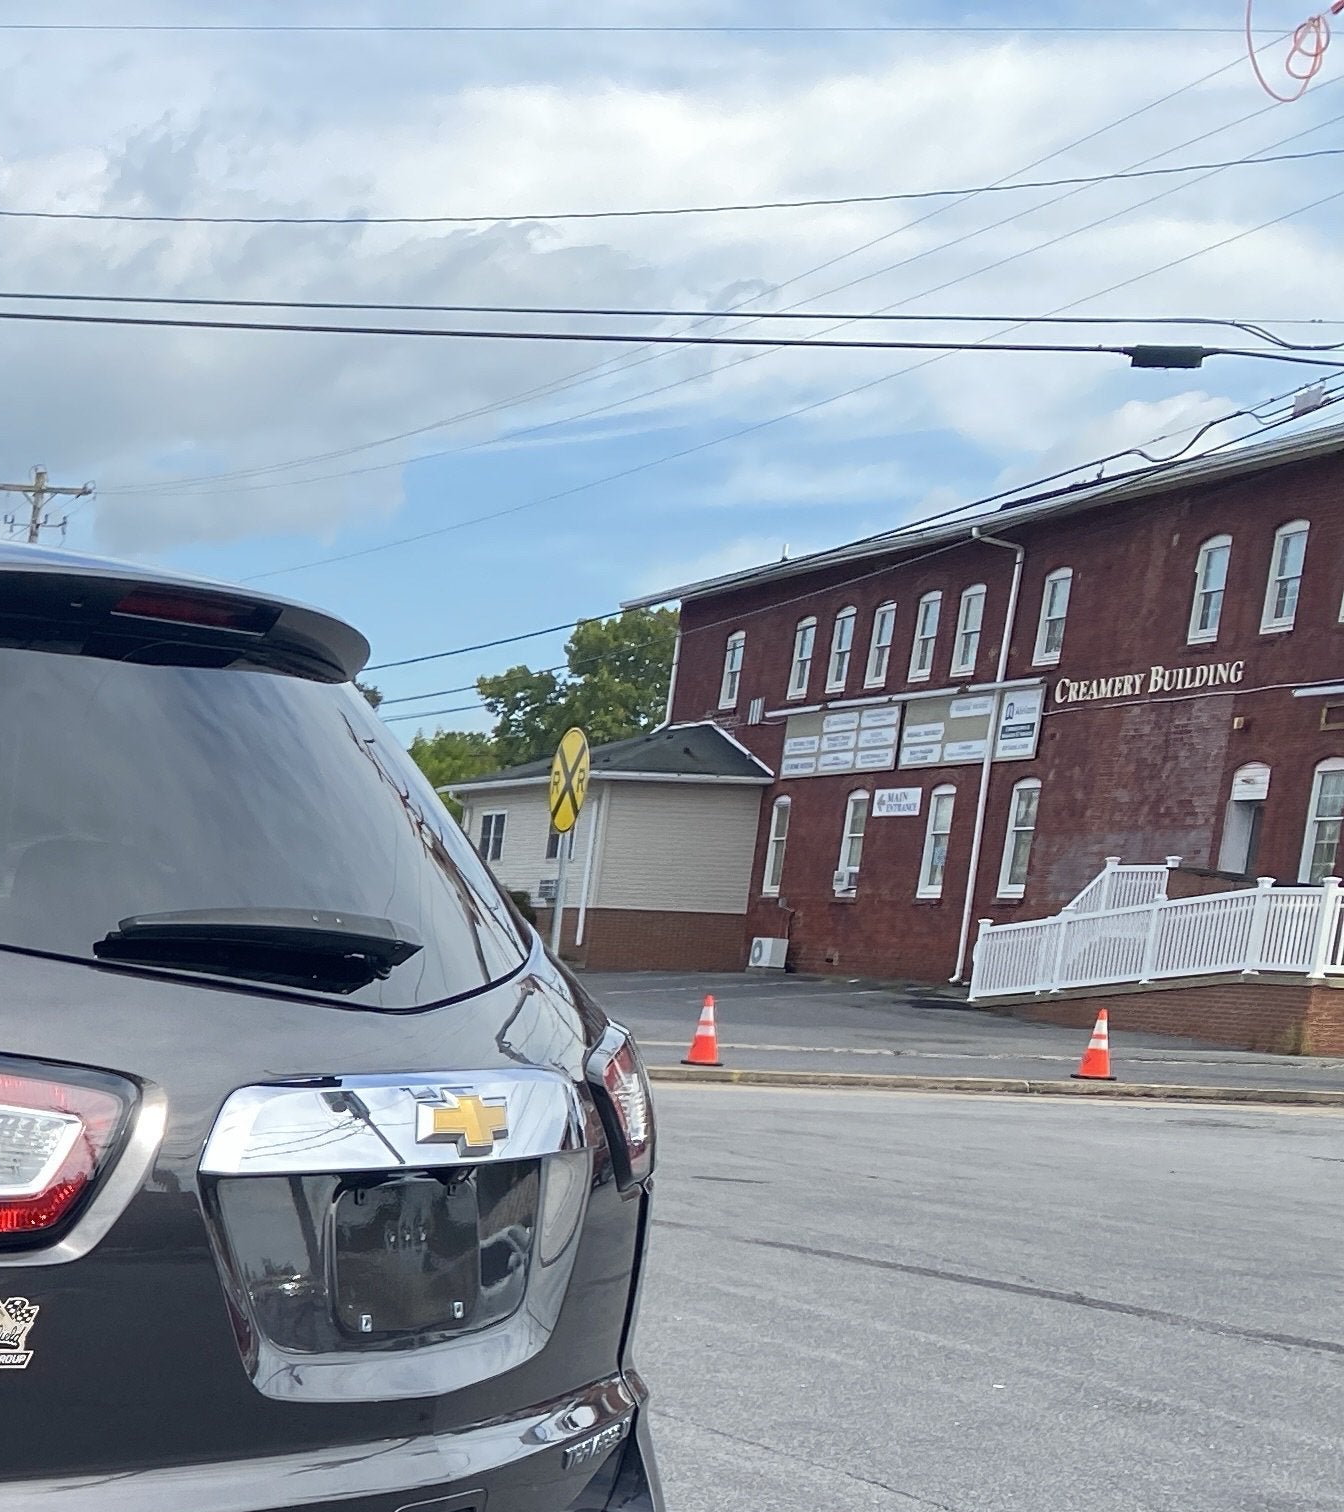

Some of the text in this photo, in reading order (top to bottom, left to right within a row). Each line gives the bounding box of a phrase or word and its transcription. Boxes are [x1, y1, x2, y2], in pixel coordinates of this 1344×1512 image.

[1054, 660, 1244, 704] CREAMERY BUILDING
[887, 791, 909, 803] MAIN
[885, 803, 918, 813] ENTRANCE
